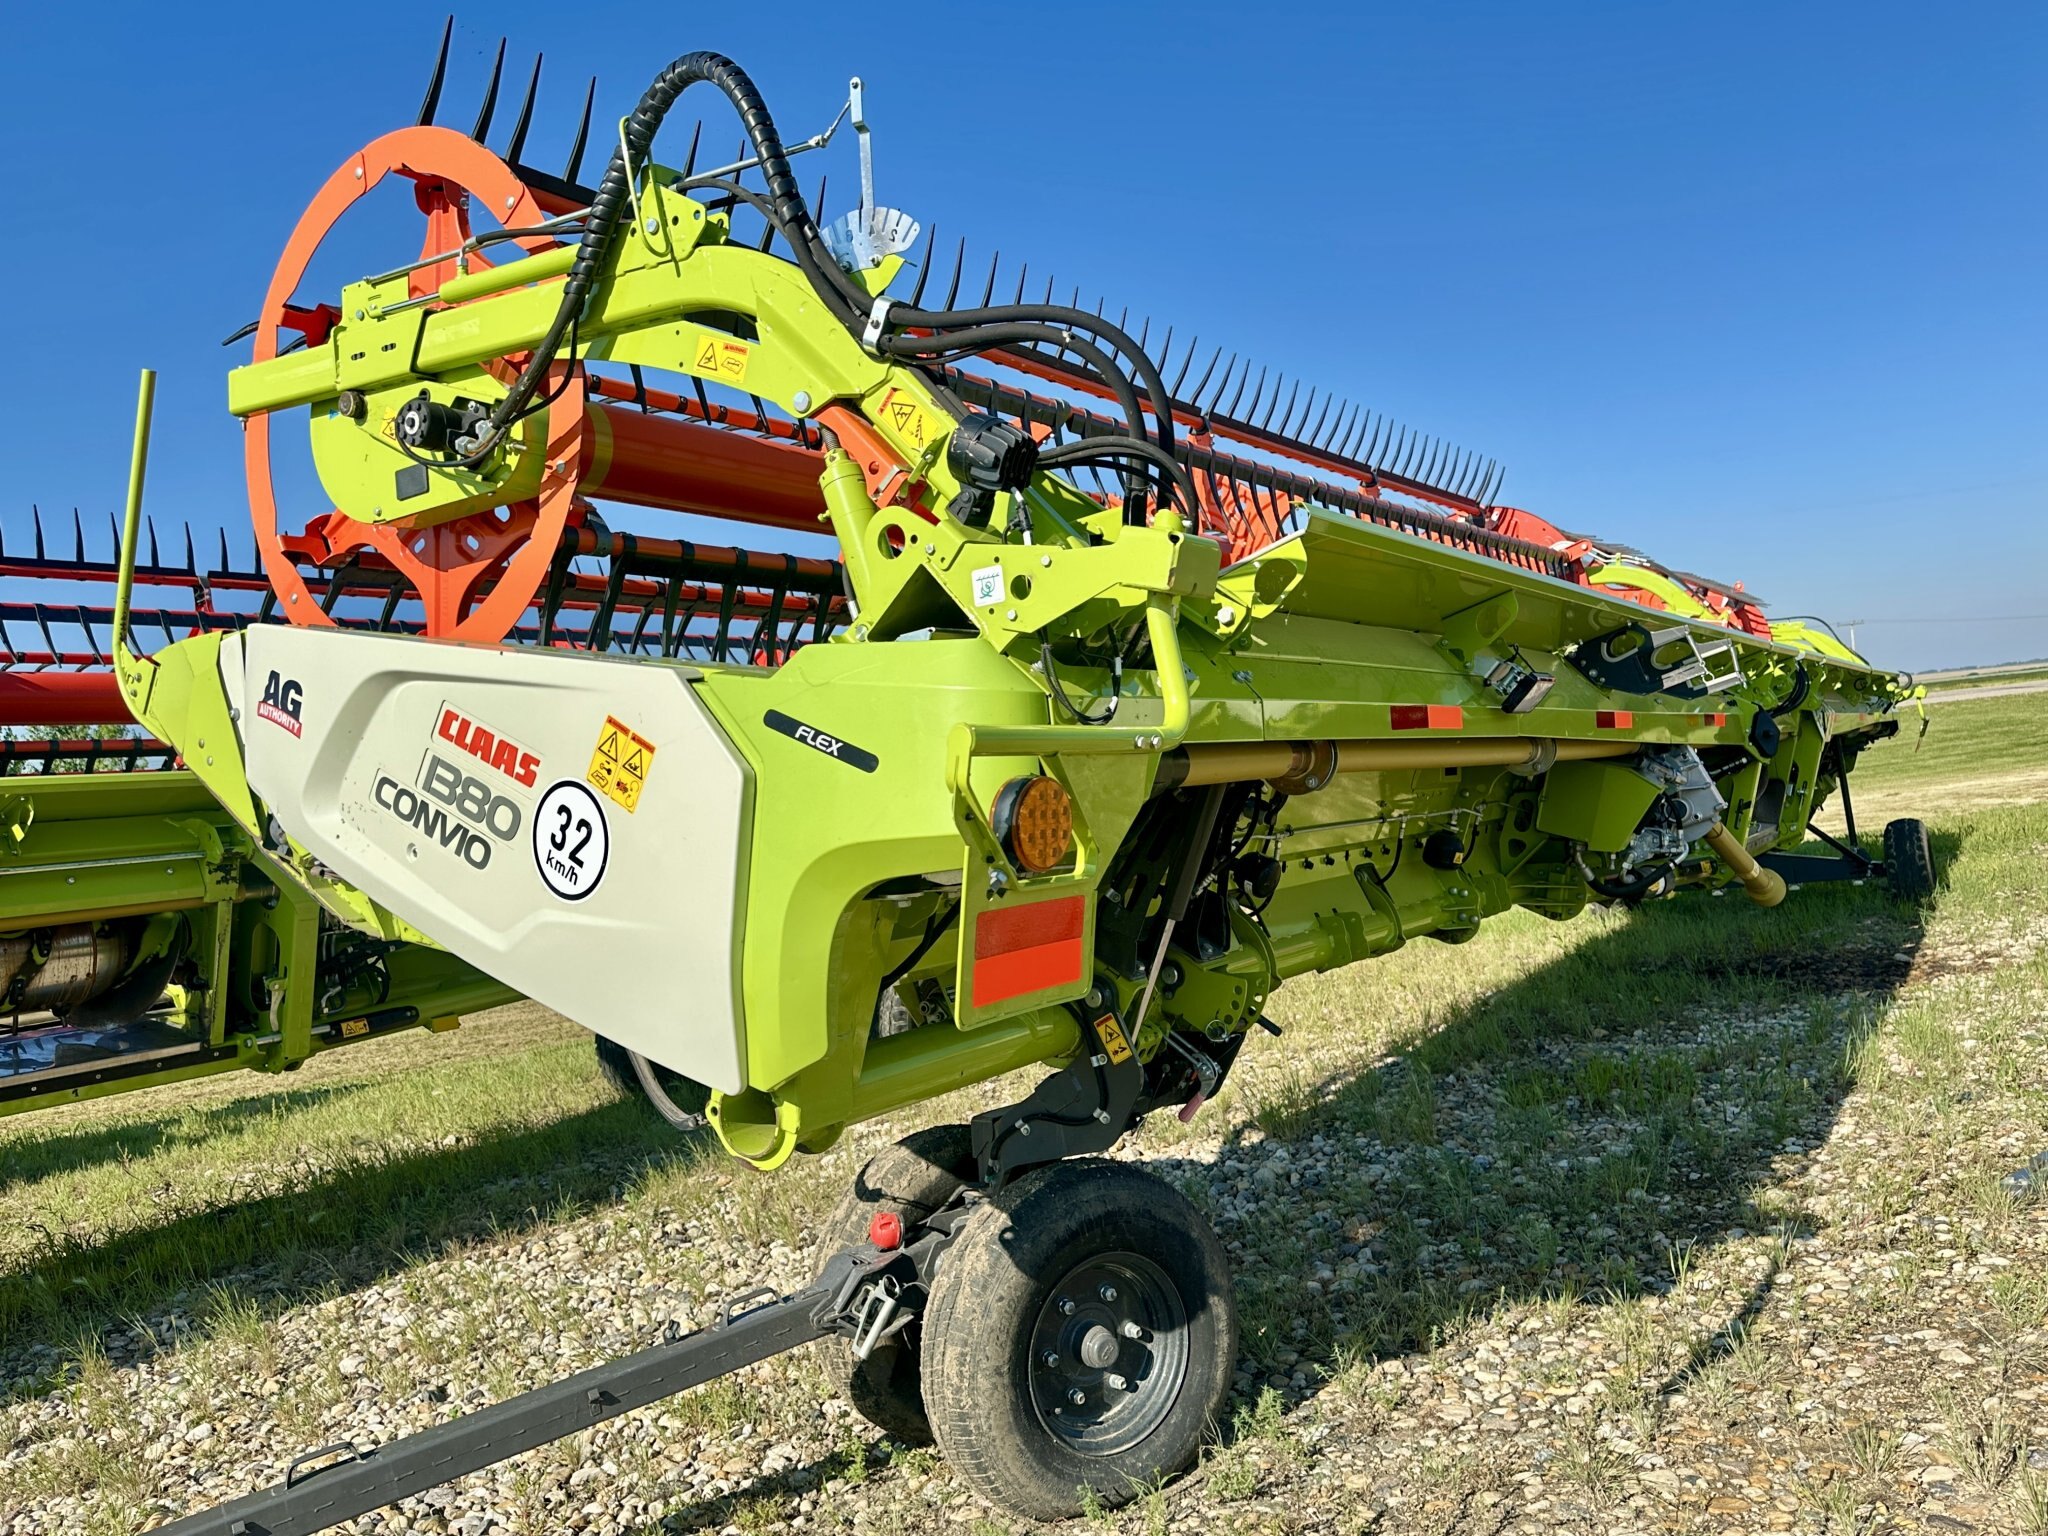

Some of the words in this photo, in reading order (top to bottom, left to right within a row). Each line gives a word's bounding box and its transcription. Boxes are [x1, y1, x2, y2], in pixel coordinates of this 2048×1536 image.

[259, 703, 301, 734] AUTHORITY
[263, 669, 304, 722] AG
[438, 709, 541, 788] CLAAS
[794, 725, 844, 757] FLEX
[375, 776, 492, 870] CONVIO
[421, 754, 522, 842] B80
[550, 803, 593, 869] 32
[546, 849, 579, 886] km/h
